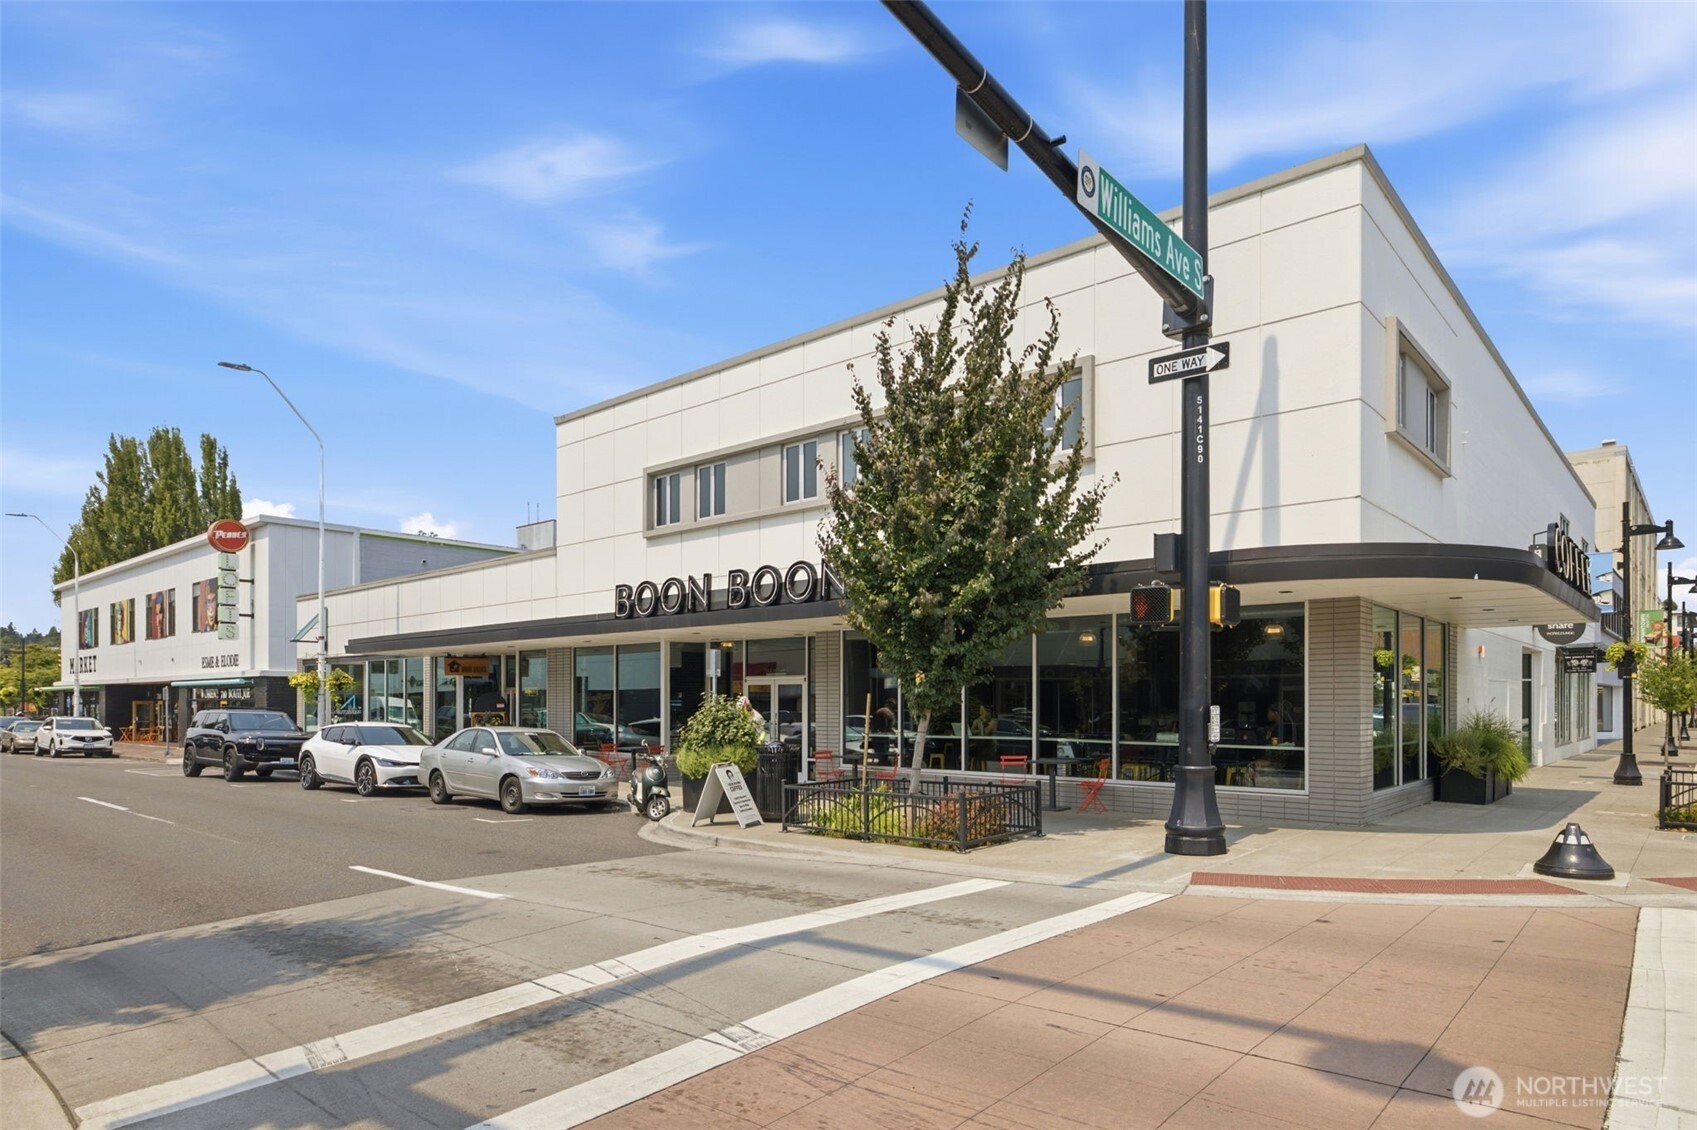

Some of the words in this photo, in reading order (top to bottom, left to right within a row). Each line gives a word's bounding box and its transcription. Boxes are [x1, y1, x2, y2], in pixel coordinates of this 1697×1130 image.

[1101, 174, 1161, 258] Williams
[1166, 235, 1190, 281] Ave
[1194, 258, 1202, 290] S
[1156, 361, 1178, 375] ONE
[1182, 355, 1205, 369] WAY
[1196, 395, 1204, 464] 5141C90
[615, 573, 712, 619] BOON
[69, 655, 97, 674] MRKET
